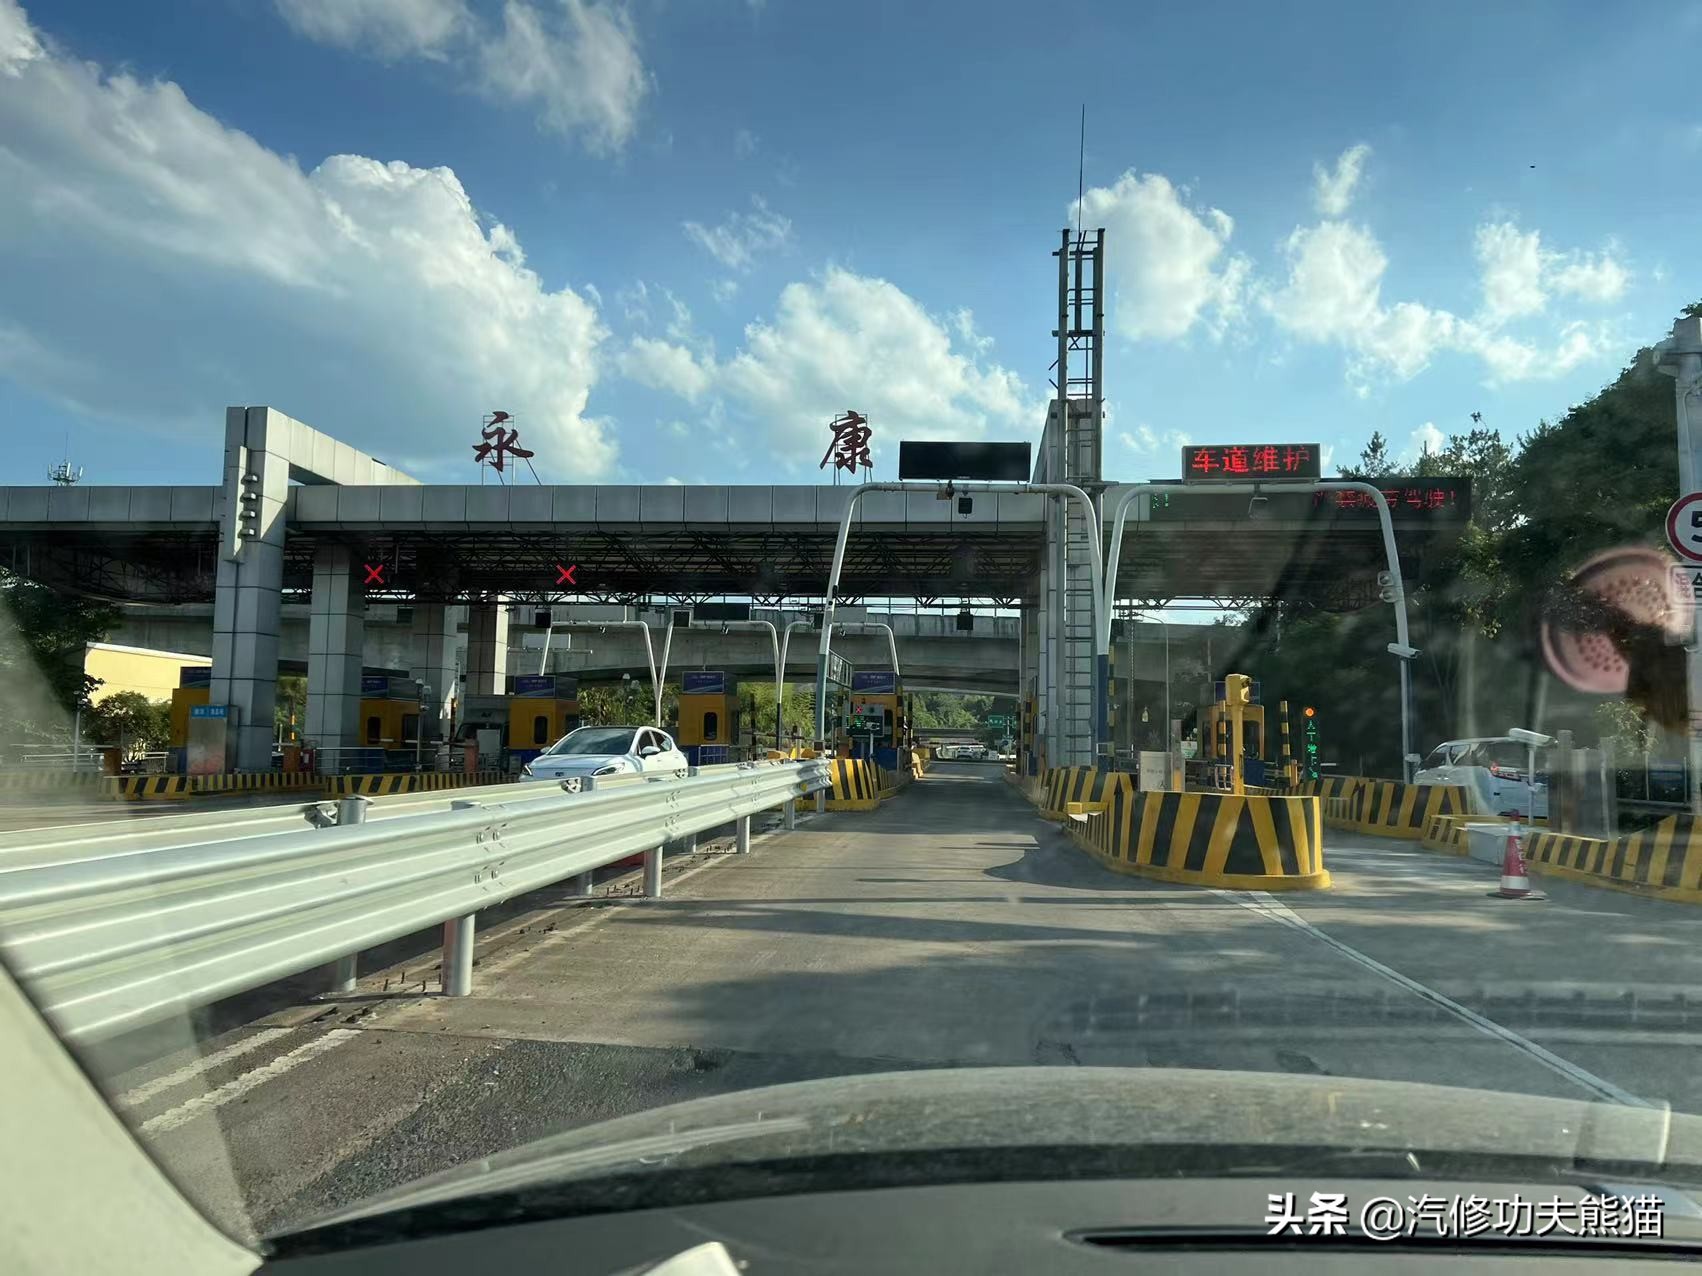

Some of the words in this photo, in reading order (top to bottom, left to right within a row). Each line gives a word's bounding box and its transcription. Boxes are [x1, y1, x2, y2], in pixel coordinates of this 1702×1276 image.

[472, 411, 534, 472] 永
[820, 410, 873, 474] 康
[1191, 446, 1310, 472] 车道维护
